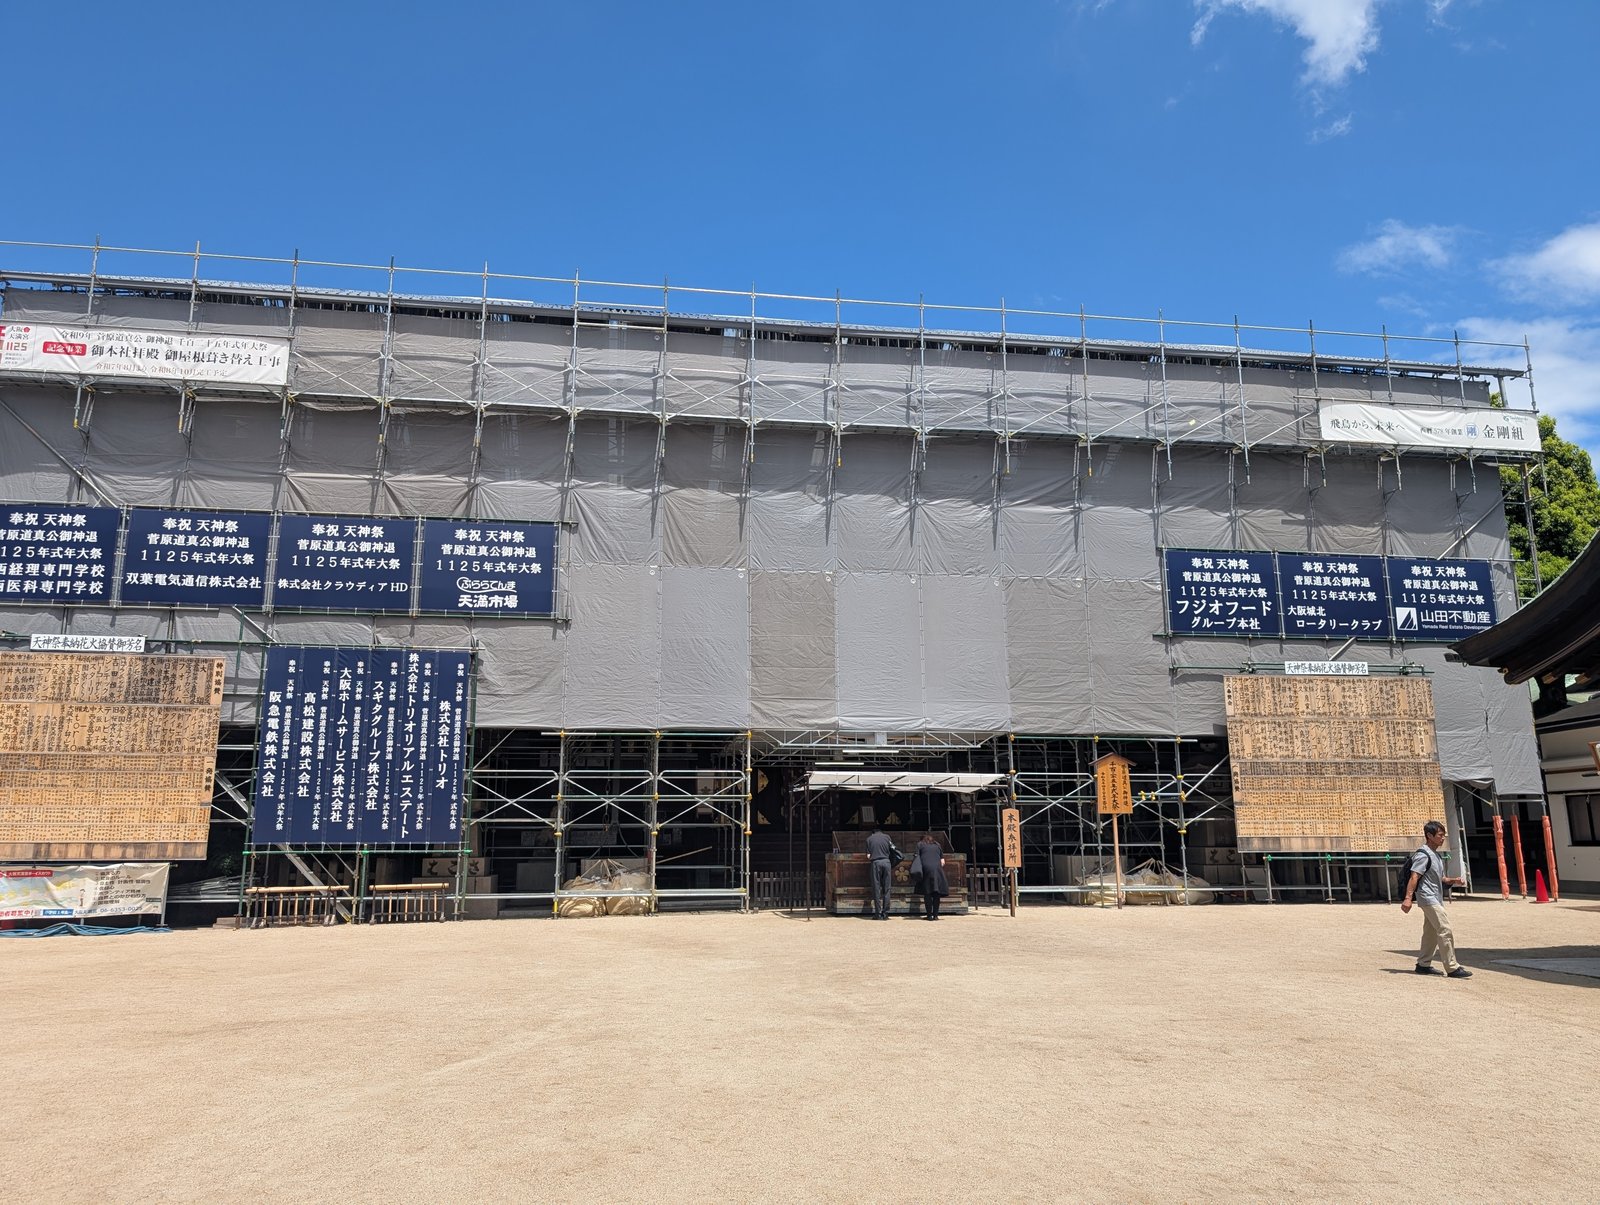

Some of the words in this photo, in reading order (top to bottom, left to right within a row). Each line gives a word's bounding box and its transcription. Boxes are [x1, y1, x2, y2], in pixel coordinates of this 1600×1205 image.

[47, 344, 83, 354] 記念事業
[92, 344, 159, 360] 御本社拝殿
[165, 347, 280, 367] 御屋根葺き替え工事
[1483, 424, 1524, 440] 金剛組
[9, 512, 38, 526] 奉祝
[44, 514, 87, 527] 天神祭
[163, 518, 191, 531] 奉祝
[197, 519, 239, 532] 天神祭
[312, 524, 339, 537] 奉祝
[344, 524, 384, 538] 天神祭
[454, 528, 481, 542] 奉祝
[486, 530, 525, 542] 天神祭
[147, 534, 249, 549] 菅原道真公御神退
[297, 539, 395, 554] 菅原道真公御神退
[440, 544, 537, 558] 菅原道真公御神退
[1191, 557, 1213, 570] 奉祝
[1216, 558, 1249, 570] 天神祭
[1302, 561, 1324, 573] 奉祝
[1327, 561, 1358, 574] 天神祭
[1182, 571, 1261, 584] 菅原道真公御神退
[1410, 565, 1432, 577] 奉祝
[1436, 565, 1466, 578] 天神祭
[125, 572, 262, 589] 双葉電気通信株式会社
[1294, 575, 1370, 588] 菅原道真公御神退
[1403, 579, 1478, 591] 菅原道真公御神退
[458, 594, 518, 608] 天満市場
[1176, 599, 1272, 617] フジオフード
[1287, 605, 1326, 617] 大阪城北
[1420, 609, 1491, 624] 山田不動産
[1191, 617, 1261, 630] グループ本社
[1296, 619, 1382, 631] ロータリークラブ
[288, 660, 296, 673] 奉祝
[323, 661, 330, 674] 奉祝
[357, 661, 364, 674] 奉祝
[390, 662, 398, 675] 奉祝
[424, 663, 431, 676] 奉祝
[457, 663, 465, 676] 奉祝
[286, 680, 295, 698] 天神祭
[321, 680, 329, 699] 天神祭
[355, 681, 363, 700] 天神祭
[389, 681, 397, 701] 天神祭
[455, 682, 463, 702] 天神祭
[261, 691, 282, 797] 阪急電鉄株式会社
[330, 668, 352, 823] 大阪ホームサービス株式会社
[365, 680, 384, 810] スギタグループ株式会社
[1006, 812, 1018, 864] 本殿参拝所
